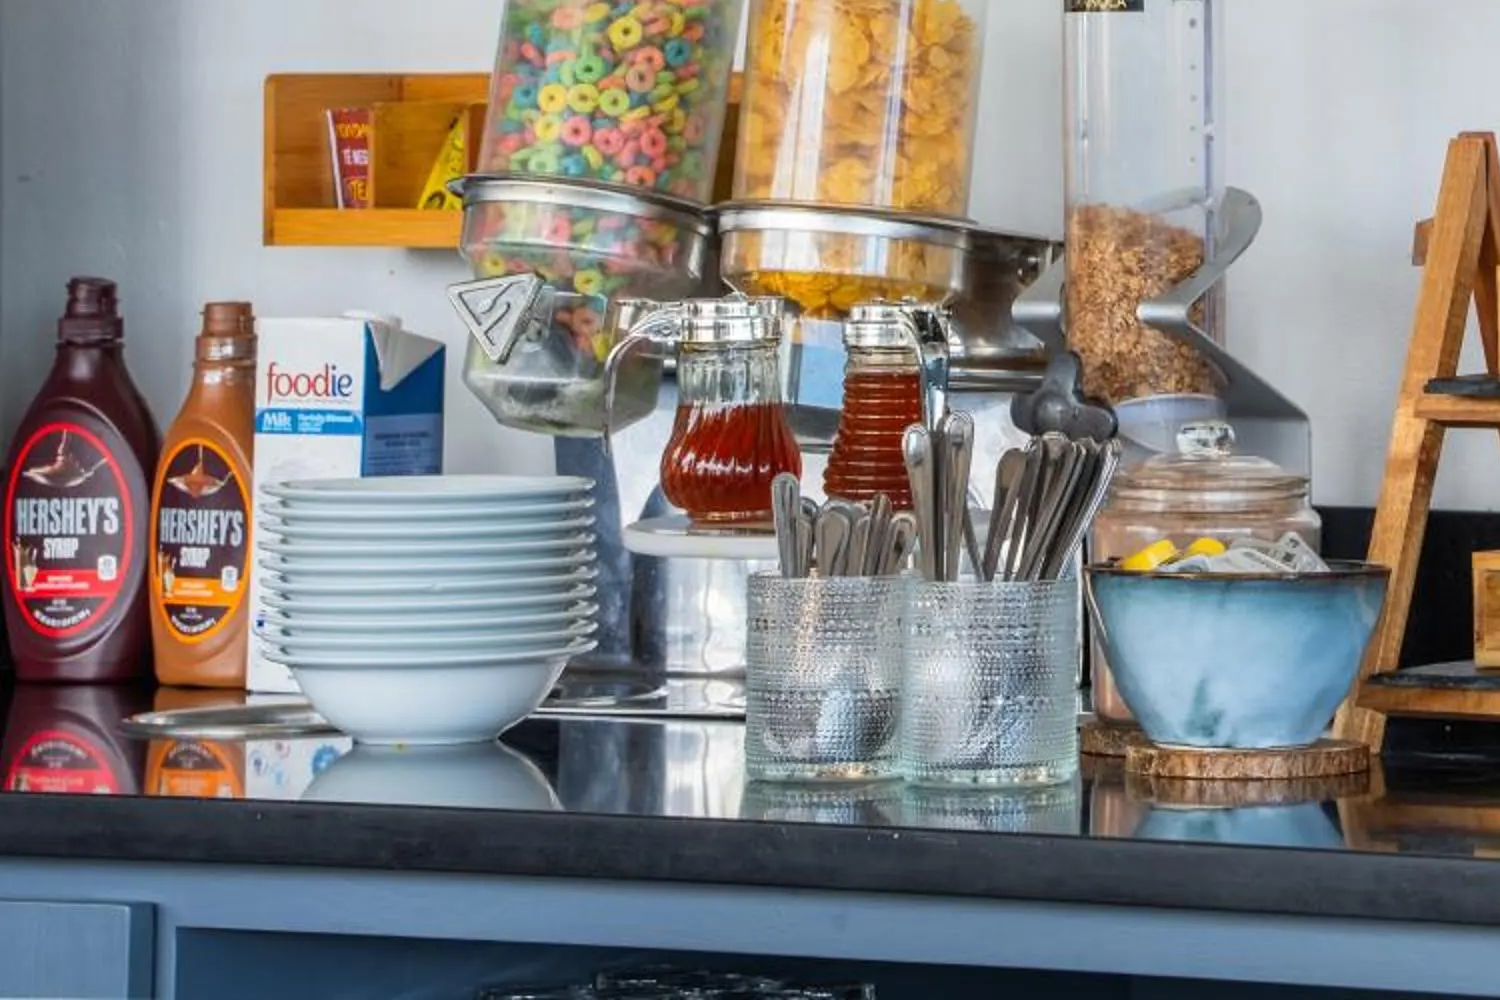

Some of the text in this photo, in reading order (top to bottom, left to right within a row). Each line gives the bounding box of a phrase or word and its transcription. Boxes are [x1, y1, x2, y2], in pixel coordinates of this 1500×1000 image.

[267, 361, 352, 405] foodie
[16, 497, 118, 535] HERSHEY'S
[160, 507, 244, 547] HERSHEY'S
